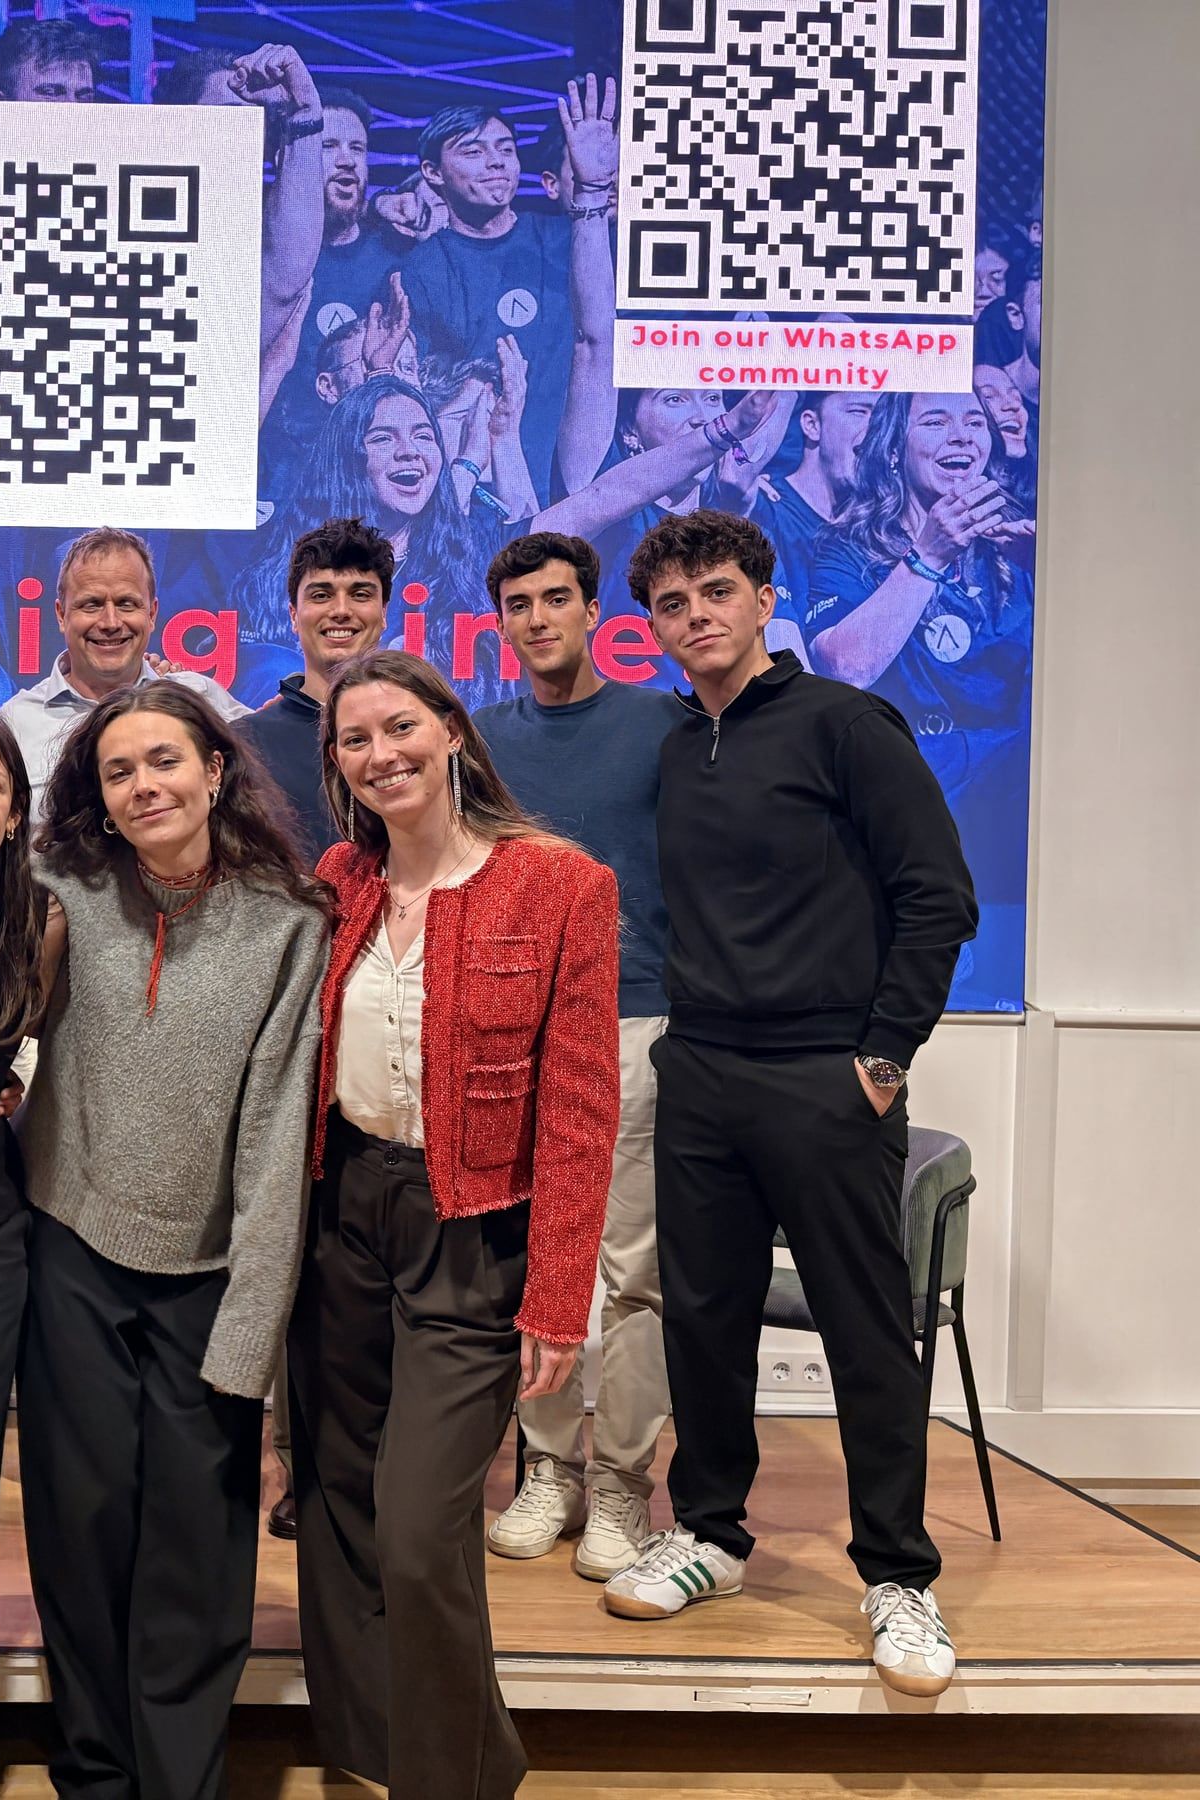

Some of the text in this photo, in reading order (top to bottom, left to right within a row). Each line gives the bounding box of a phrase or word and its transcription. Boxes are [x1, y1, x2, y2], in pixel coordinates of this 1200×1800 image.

[632, 324, 957, 355] Join our WhatsApp
[699, 362, 889, 390] community
